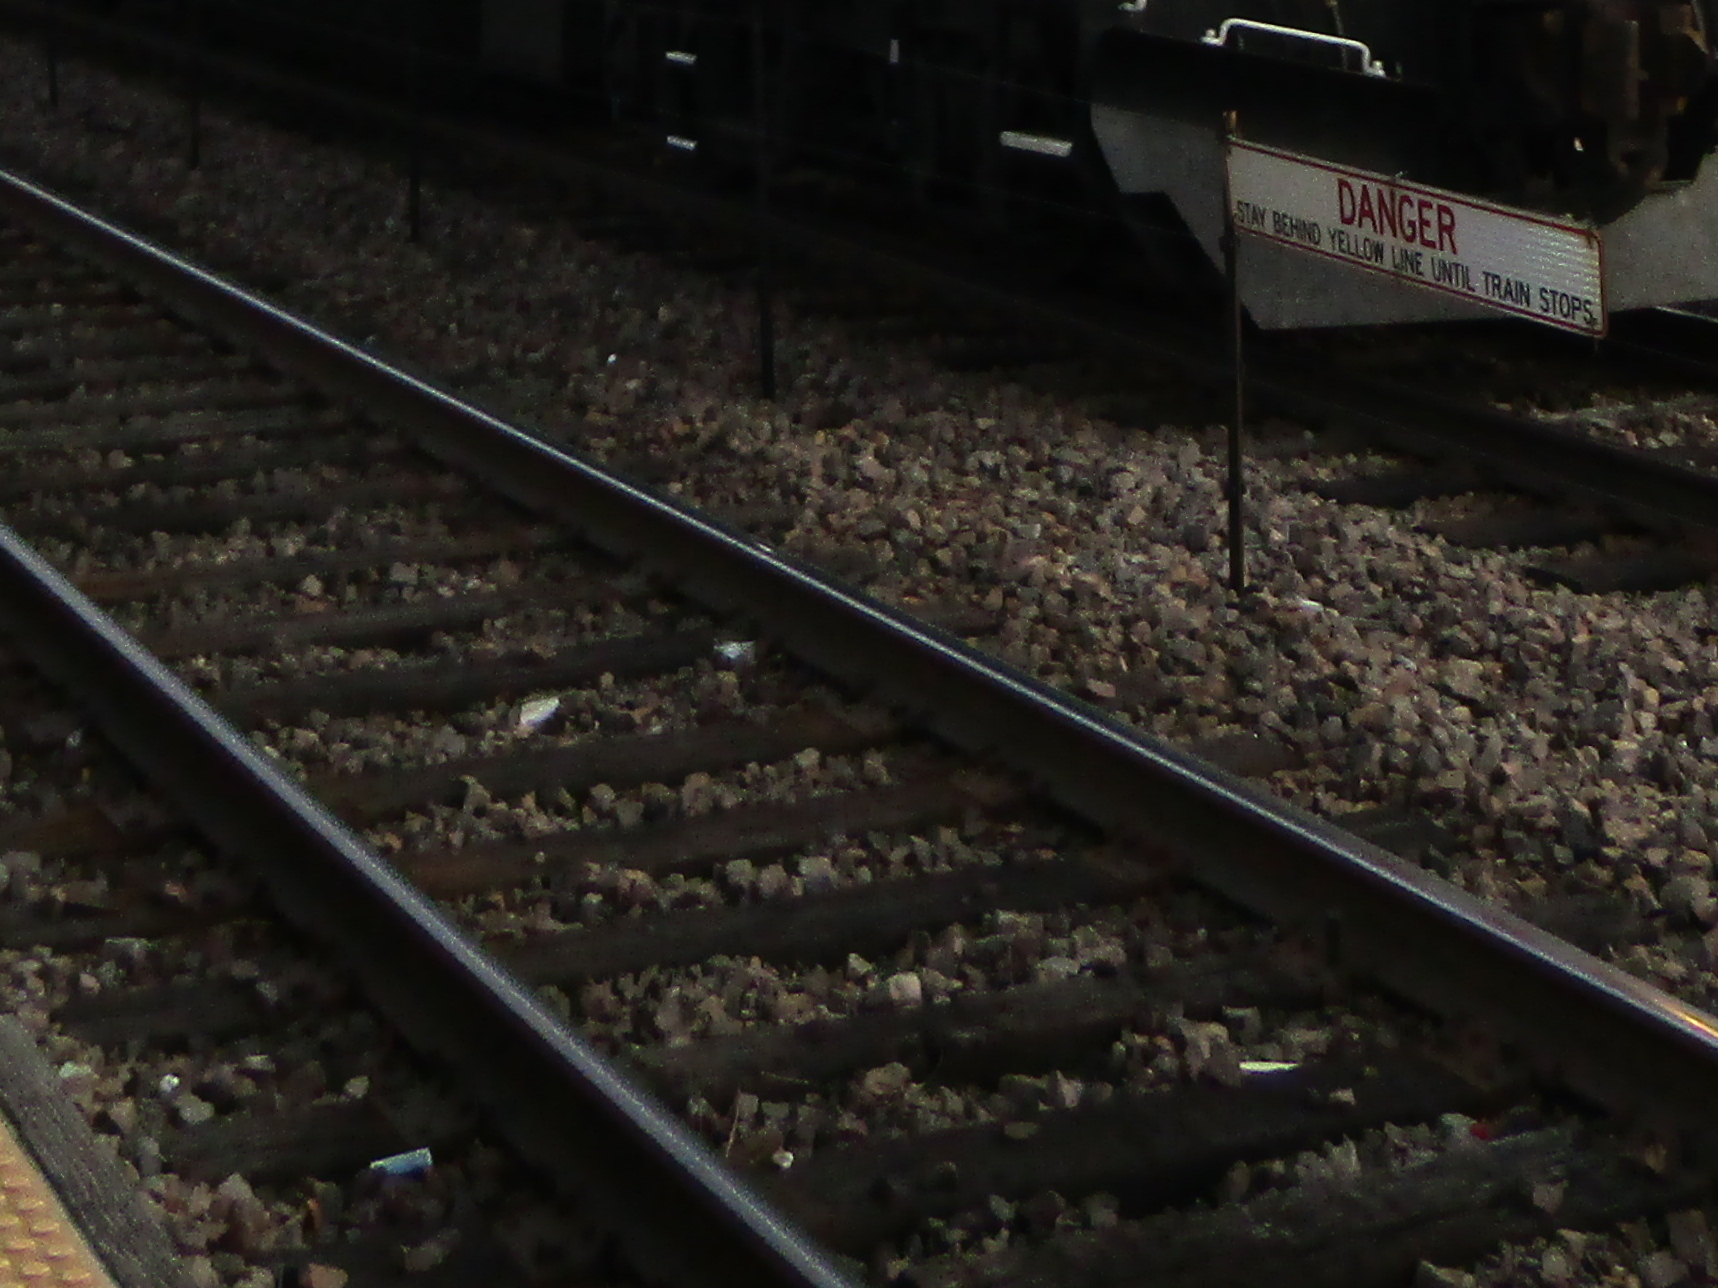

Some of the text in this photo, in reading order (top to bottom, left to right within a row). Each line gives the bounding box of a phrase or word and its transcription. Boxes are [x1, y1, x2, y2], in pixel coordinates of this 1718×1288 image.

[1237, 200, 1266, 227] STAY
[1272, 210, 1321, 245] BEHIND
[1327, 227, 1384, 264] YELLOW
[1392, 245, 1423, 277] LINE
[1431, 257, 1476, 292] UNTIL
[1483, 271, 1531, 307] TRAIN
[1337, 177, 1458, 255] DANGER
